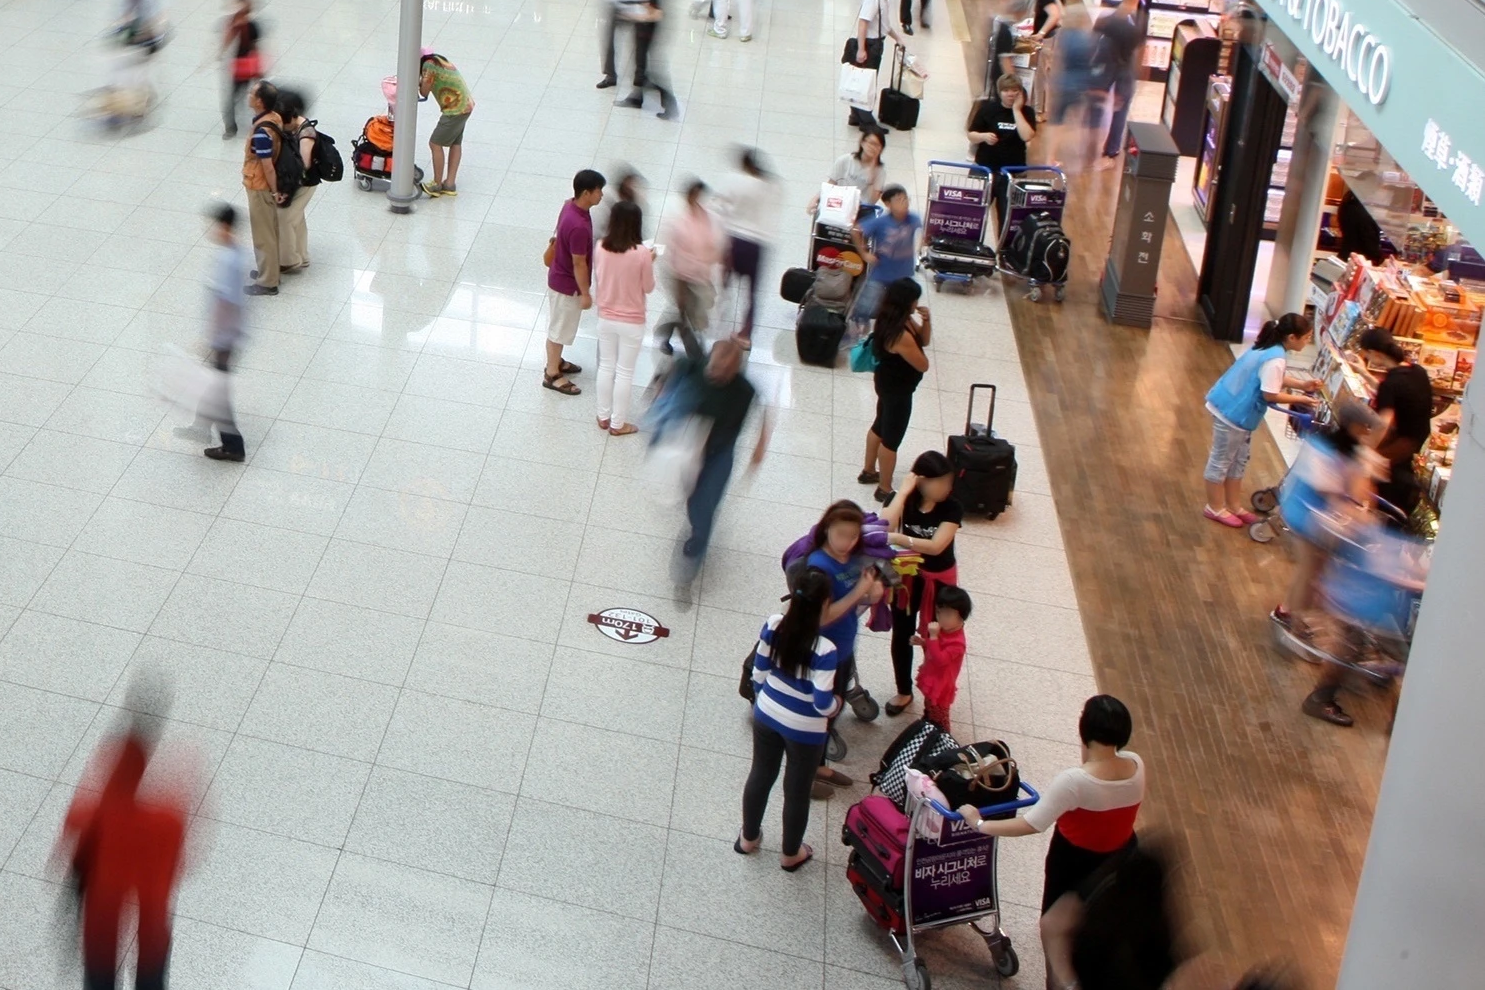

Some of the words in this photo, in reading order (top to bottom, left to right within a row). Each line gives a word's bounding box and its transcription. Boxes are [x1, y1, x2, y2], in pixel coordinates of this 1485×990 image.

[943, 189, 963, 199] VISA
[1030, 194, 1047, 203] VISA
[601, 617, 637, 630] 170m
[915, 865, 935, 879] 비자
[937, 855, 987, 874] 시그니처로
[930, 871, 971, 890] 누리세요
[975, 897, 991, 907] VISA
